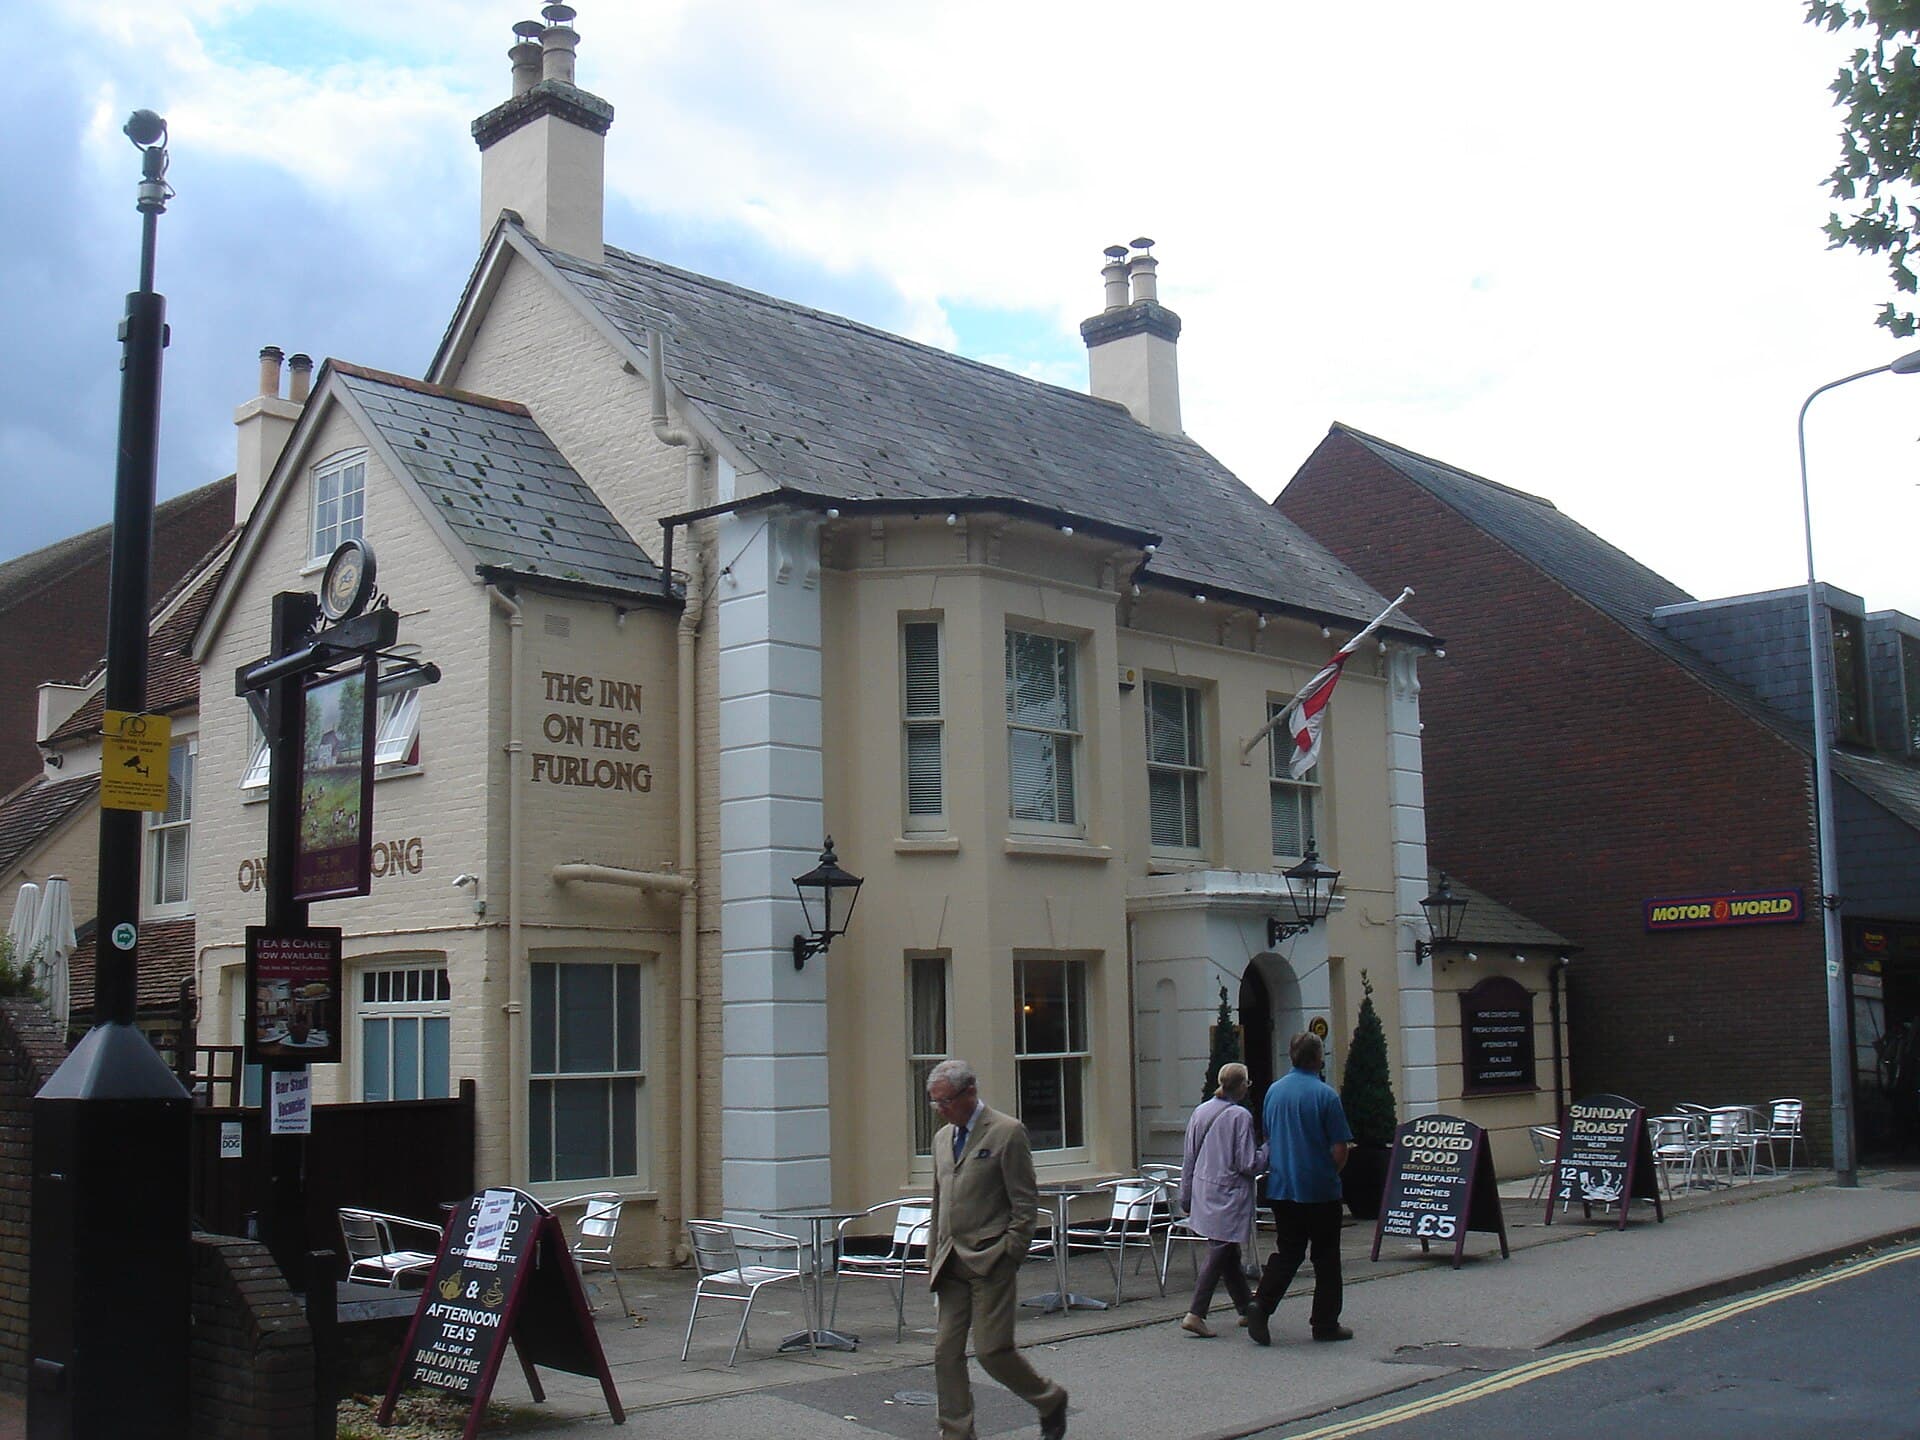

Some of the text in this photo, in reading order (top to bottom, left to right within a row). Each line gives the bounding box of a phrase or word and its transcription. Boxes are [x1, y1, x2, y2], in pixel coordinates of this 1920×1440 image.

[541, 671, 642, 714] THE INN
[543, 713, 641, 752] ON THE
[531, 753, 652, 793] FURLONG
[1652, 899, 1792, 921] MOTOR WORLD
[257, 939, 331, 949] TEA & CAKES
[257, 952, 331, 960] NOW AVAILABLE
[275, 1076, 308, 1095] Bar Staff
[278, 1097, 306, 1118] Vacancies
[1569, 1105, 1637, 1120] SUNDAY
[1415, 1120, 1466, 1135] HOME
[1572, 1119, 1629, 1134] ROAST
[223, 1140, 240, 1149] DOG
[1402, 1135, 1473, 1151] COOKED
[1410, 1150, 1459, 1165] FOOD
[1402, 1163, 1431, 1171] SERVED
[1446, 1165, 1461, 1173] DAY
[1560, 1167, 1577, 1180] 12
[1401, 1172, 1458, 1184] BREAKFAST
[1403, 1187, 1451, 1197] LUNCHES
[1559, 1188, 1571, 1199] 4
[1400, 1201, 1449, 1211] SPECIALS
[1387, 1210, 1414, 1219] MEALS
[1388, 1218, 1411, 1226] FROM
[1384, 1226, 1412, 1235] UNDER
[1416, 1214, 1457, 1238] £5
[463, 1259, 498, 1271] ESPRESSO
[466, 1280, 480, 1299] &
[425, 1302, 502, 1328] AFTERNOON
[441, 1323, 477, 1342] TEA'S
[432, 1341, 474, 1356] ALL DAY AT
[415, 1349, 481, 1374] INN ON THE
[413, 1367, 470, 1390] FURLONG
